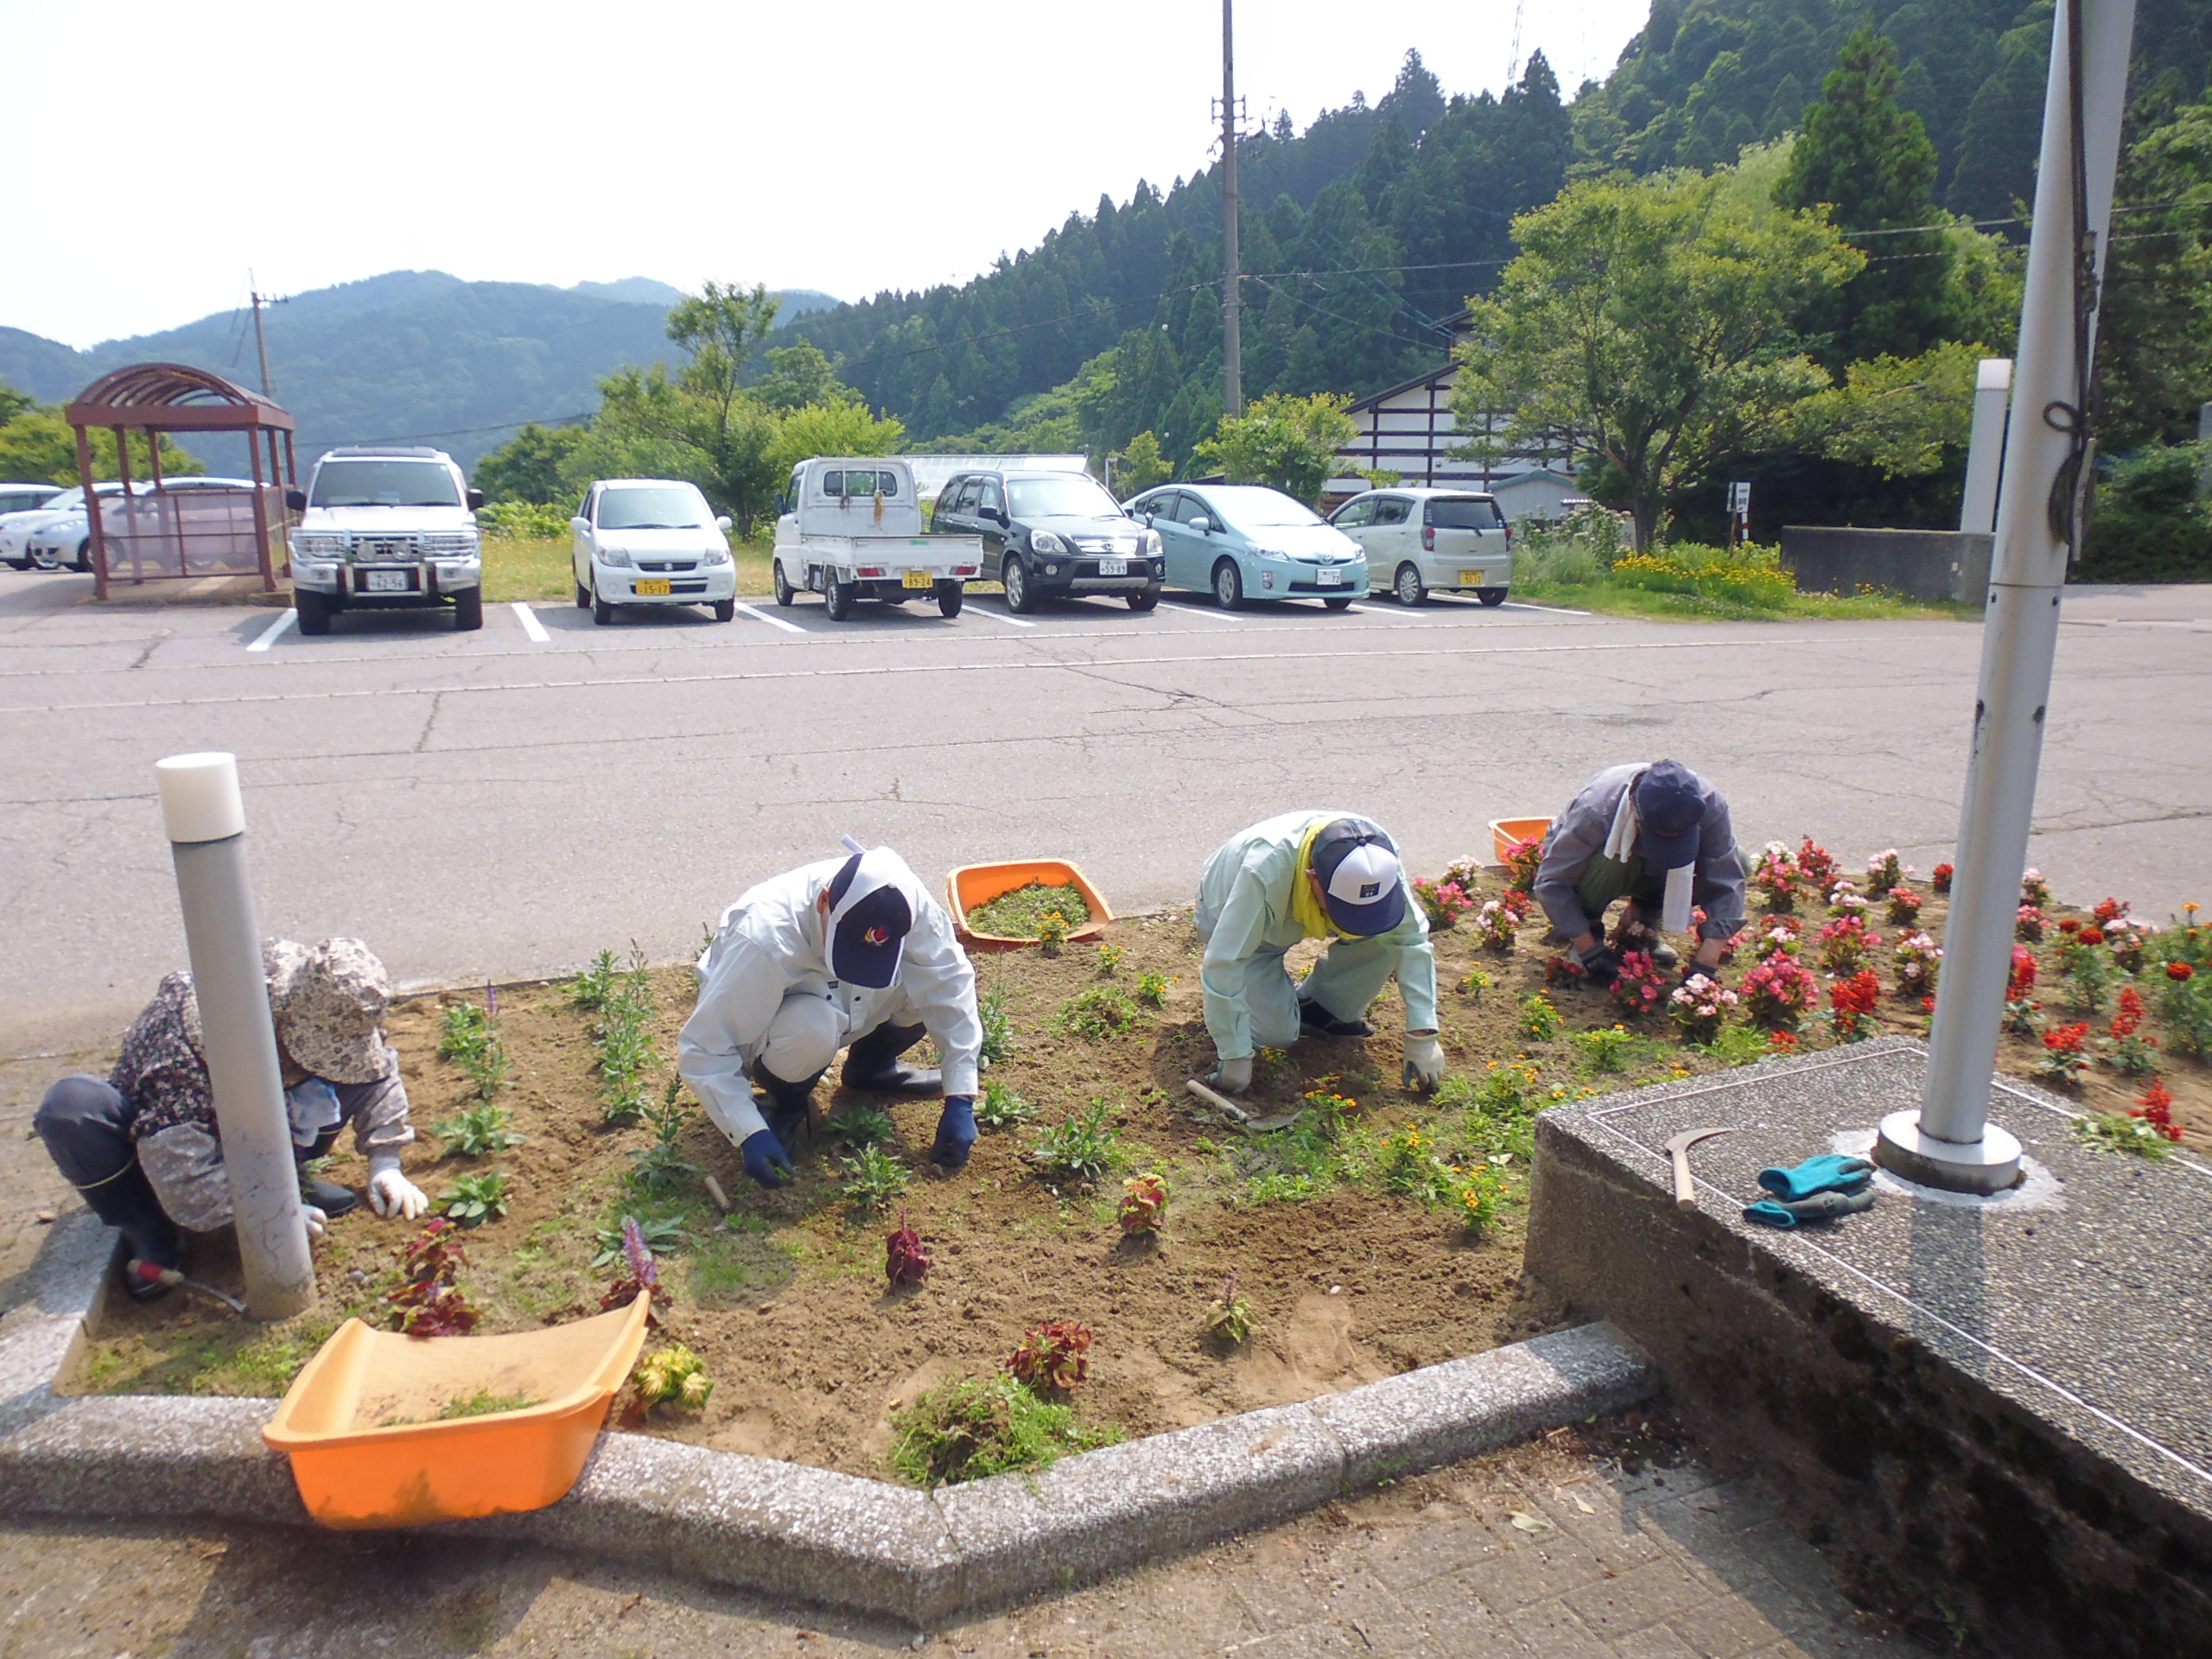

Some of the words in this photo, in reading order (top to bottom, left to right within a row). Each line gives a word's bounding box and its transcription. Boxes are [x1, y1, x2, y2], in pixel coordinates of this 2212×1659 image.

[1105, 565, 1126, 574] 59-89
[908, 578, 931, 587] 89-24
[644, 585, 668, 594] 15-17
